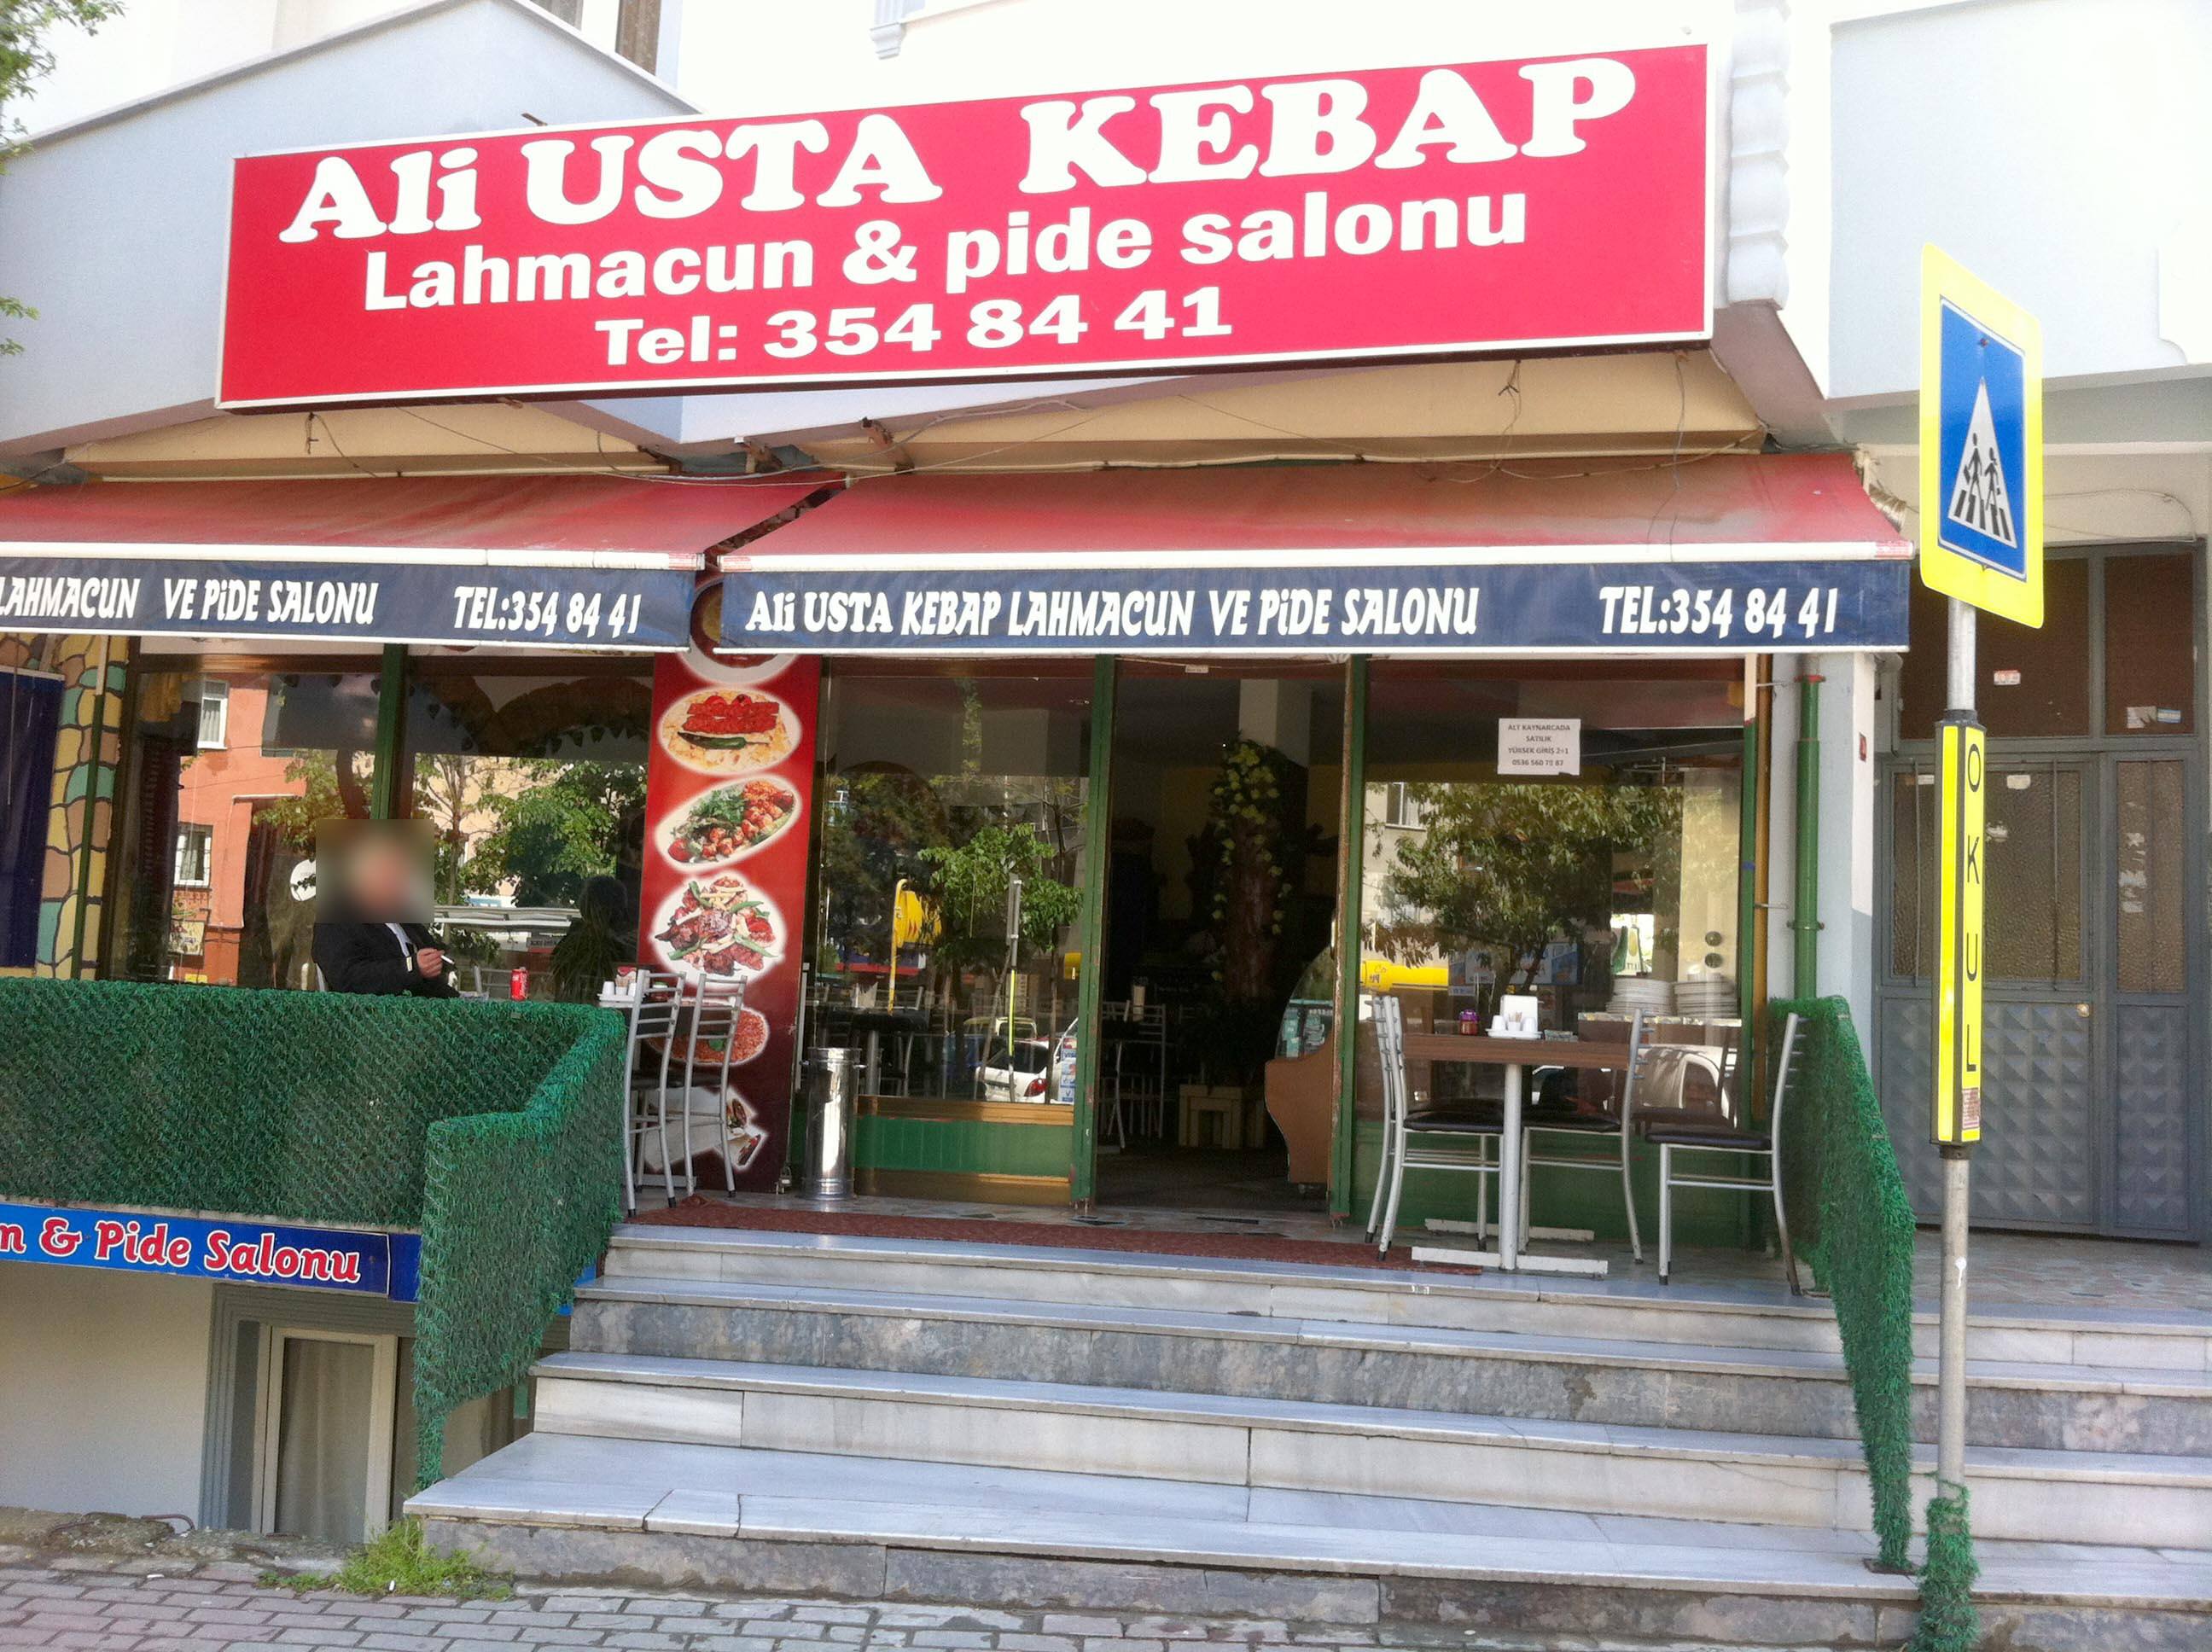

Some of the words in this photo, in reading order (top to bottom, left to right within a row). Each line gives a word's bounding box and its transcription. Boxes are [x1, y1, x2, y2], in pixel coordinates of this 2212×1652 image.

[280, 148, 482, 243] Ali
[521, 114, 943, 225] USTA
[1019, 58, 1636, 194] KEBAP
[365, 240, 813, 311] Lahmacun
[843, 220, 917, 285] &
[946, 207, 1152, 294] pide
[1180, 194, 1526, 265] salonu
[594, 316, 737, 365] Tel:
[764, 304, 941, 358] 354
[967, 295, 1088, 349] 84
[1115, 287, 1232, 340] 41
[164, 578, 198, 620] VE
[267, 579, 379, 625] SALONU
[453, 585, 560, 637] TEL:354
[566, 592, 602, 638] 84
[608, 593, 642, 639] 41
[745, 590, 795, 632] Ali
[804, 591, 894, 633] USTA
[900, 590, 1002, 637] KEBAP
[1008, 590, 1196, 637] LAHMACUN
[1208, 590, 1251, 636] VE
[1341, 587, 1480, 636] SALONU
[1599, 585, 1733, 639] TEL:354
[1744, 587, 1787, 638] 84
[1798, 587, 1838, 638] 41
[1966, 742, 1982, 1073] OKUL
[38, 1216, 83, 1257] &
[95, 1219, 192, 1268] Pide
[203, 1230, 361, 1284] Salonu
